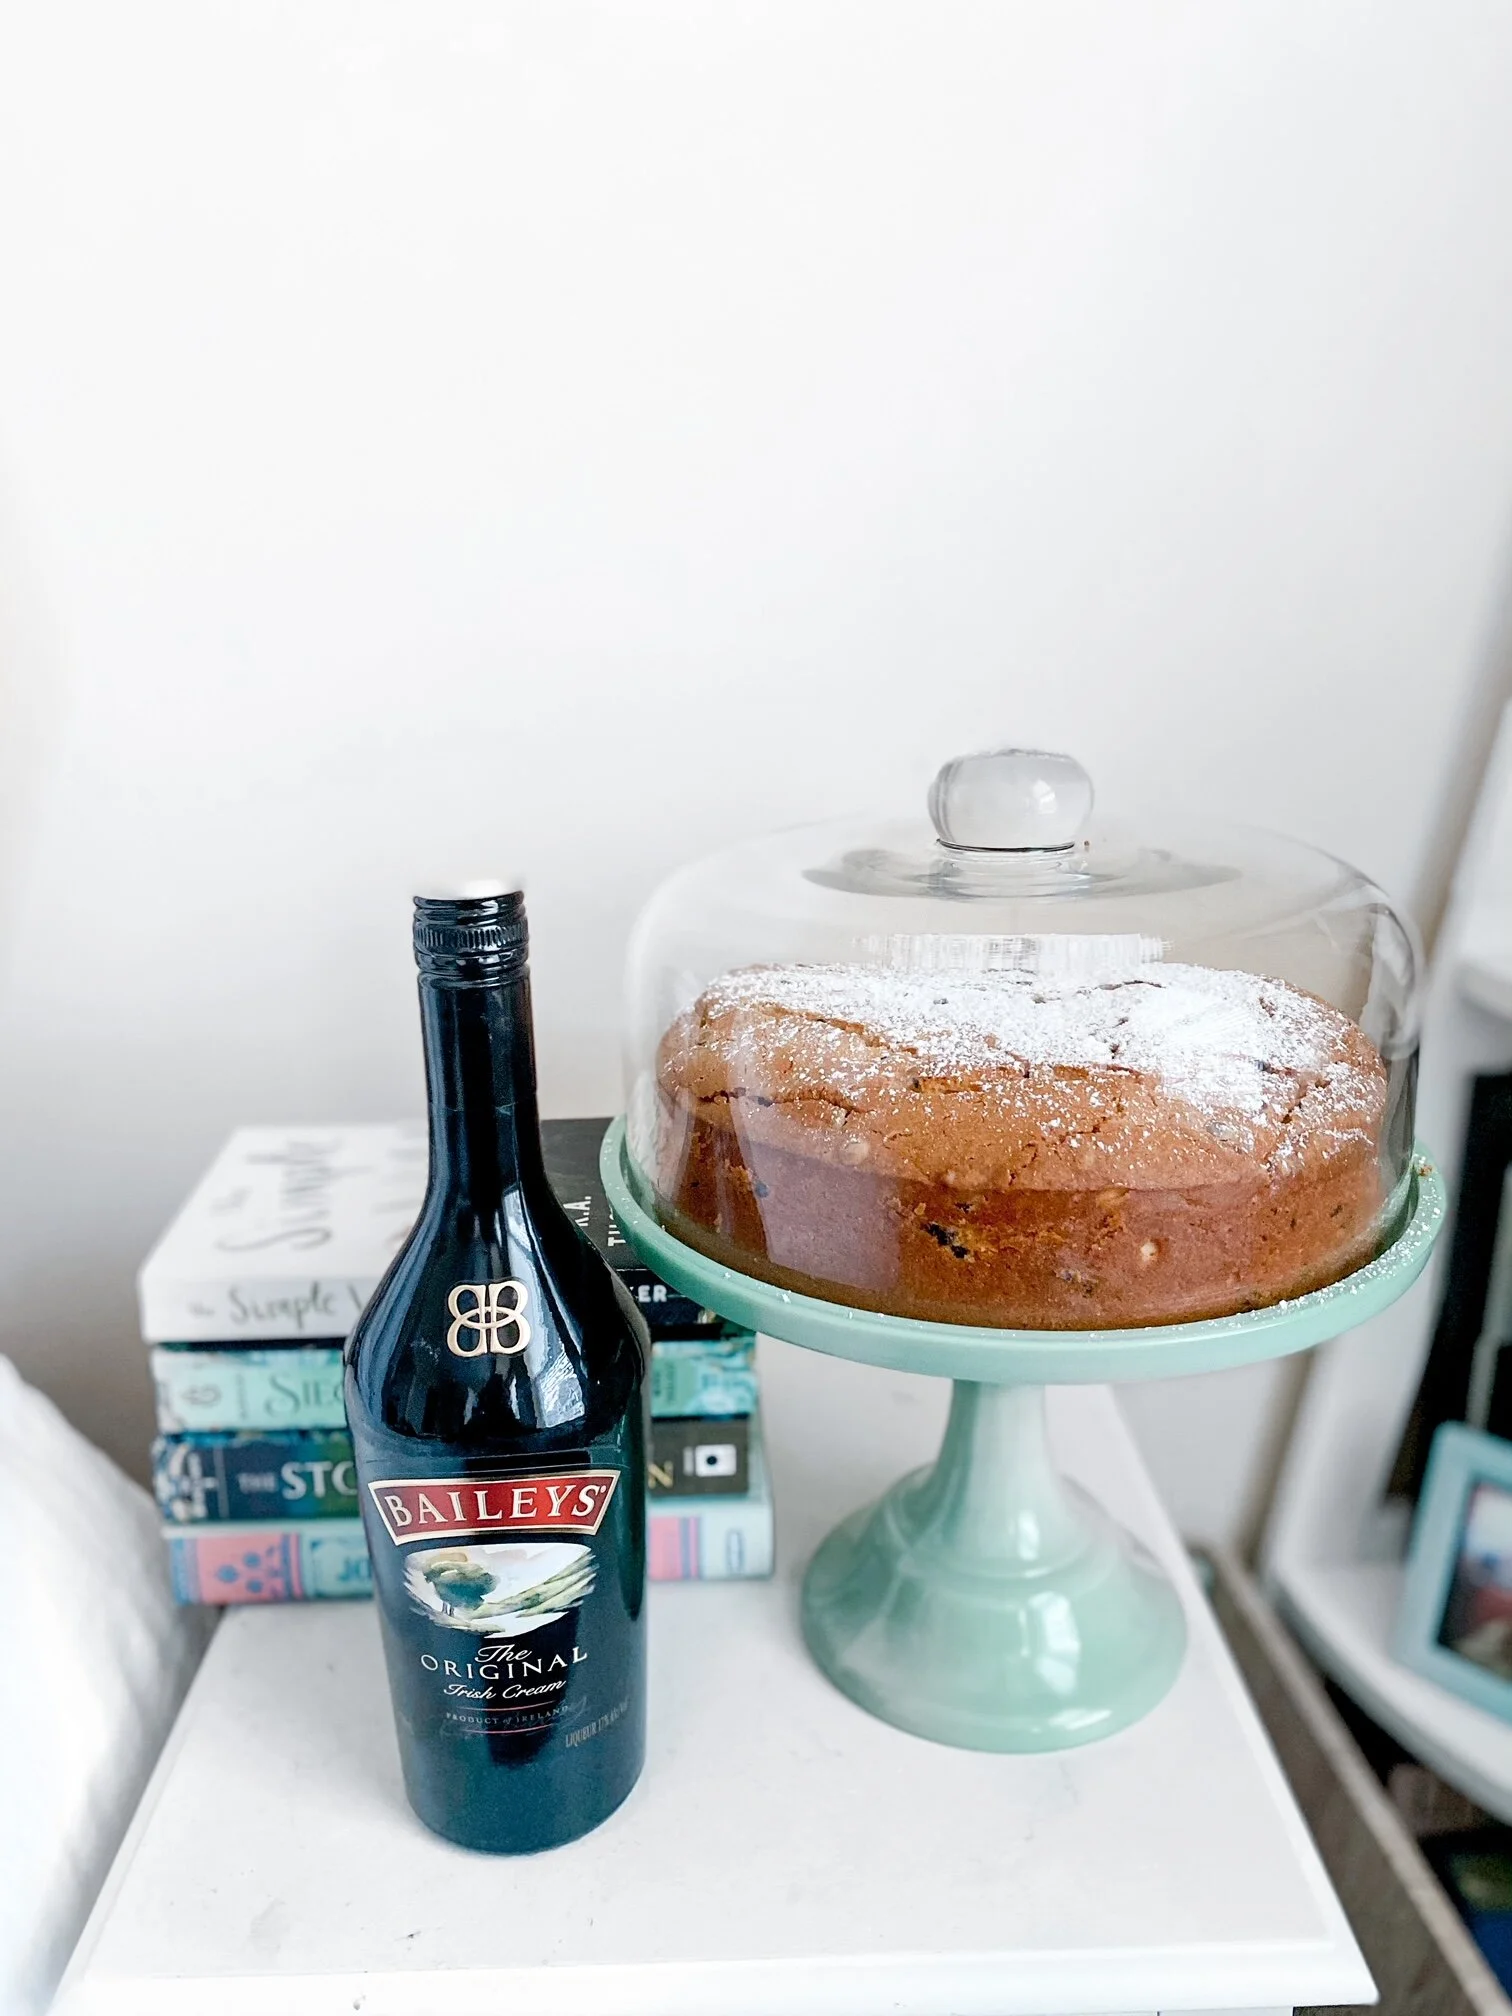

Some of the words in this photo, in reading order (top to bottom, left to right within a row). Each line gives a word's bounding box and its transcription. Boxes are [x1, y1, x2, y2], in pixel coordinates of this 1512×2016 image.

[228, 1280, 337, 1330] Simple
[384, 1484, 602, 1528] BAILEYS
[420, 1645, 588, 1680] ORIGINAL
[474, 1643, 533, 1663] The
[443, 1683, 497, 1700] Irish
[502, 1679, 567, 1700] Cream
[445, 1711, 499, 1725] PRODUCT
[515, 1704, 570, 1724] IRELAND
